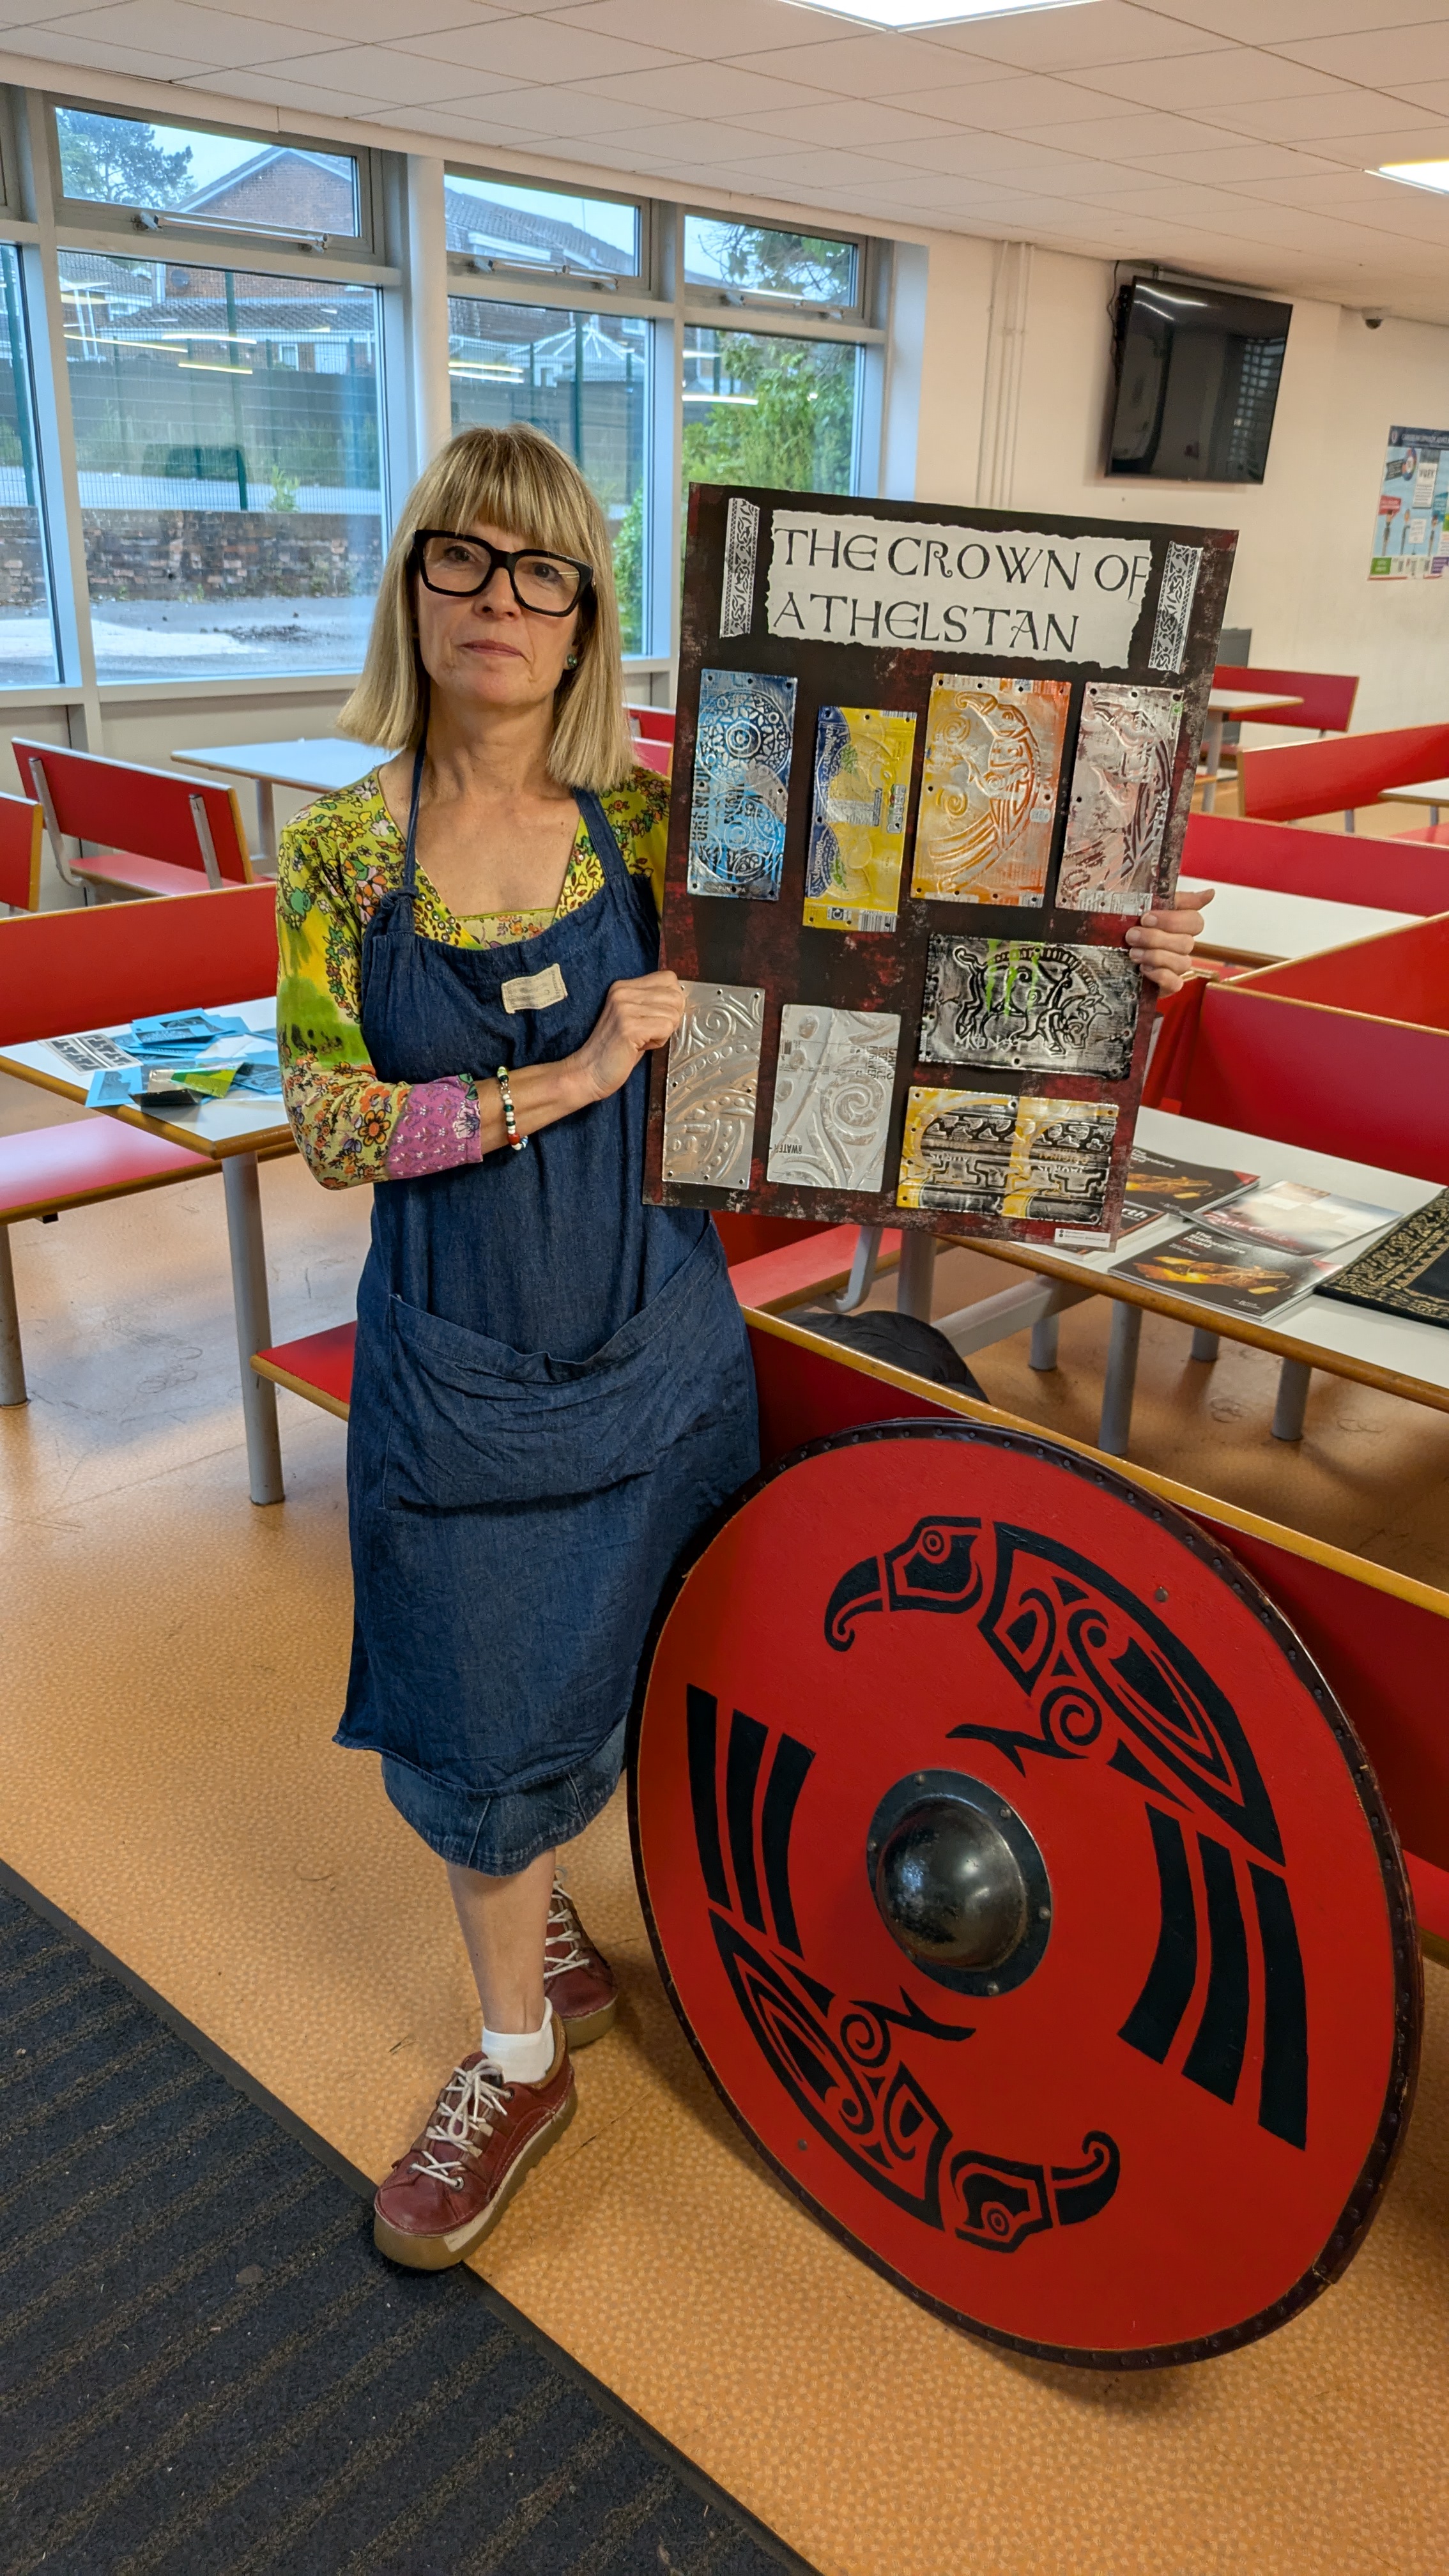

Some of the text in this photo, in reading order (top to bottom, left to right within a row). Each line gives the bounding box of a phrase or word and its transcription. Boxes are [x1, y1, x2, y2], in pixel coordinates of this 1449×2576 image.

[774, 527, 1150, 604] THE CROWN OF
[773, 591, 1080, 653] ATHELSTAN
[1183, 1236, 1212, 1248] Hoard
[1188, 1234, 1246, 1254] Staffordshire
[1195, 1230, 1213, 1239] The
